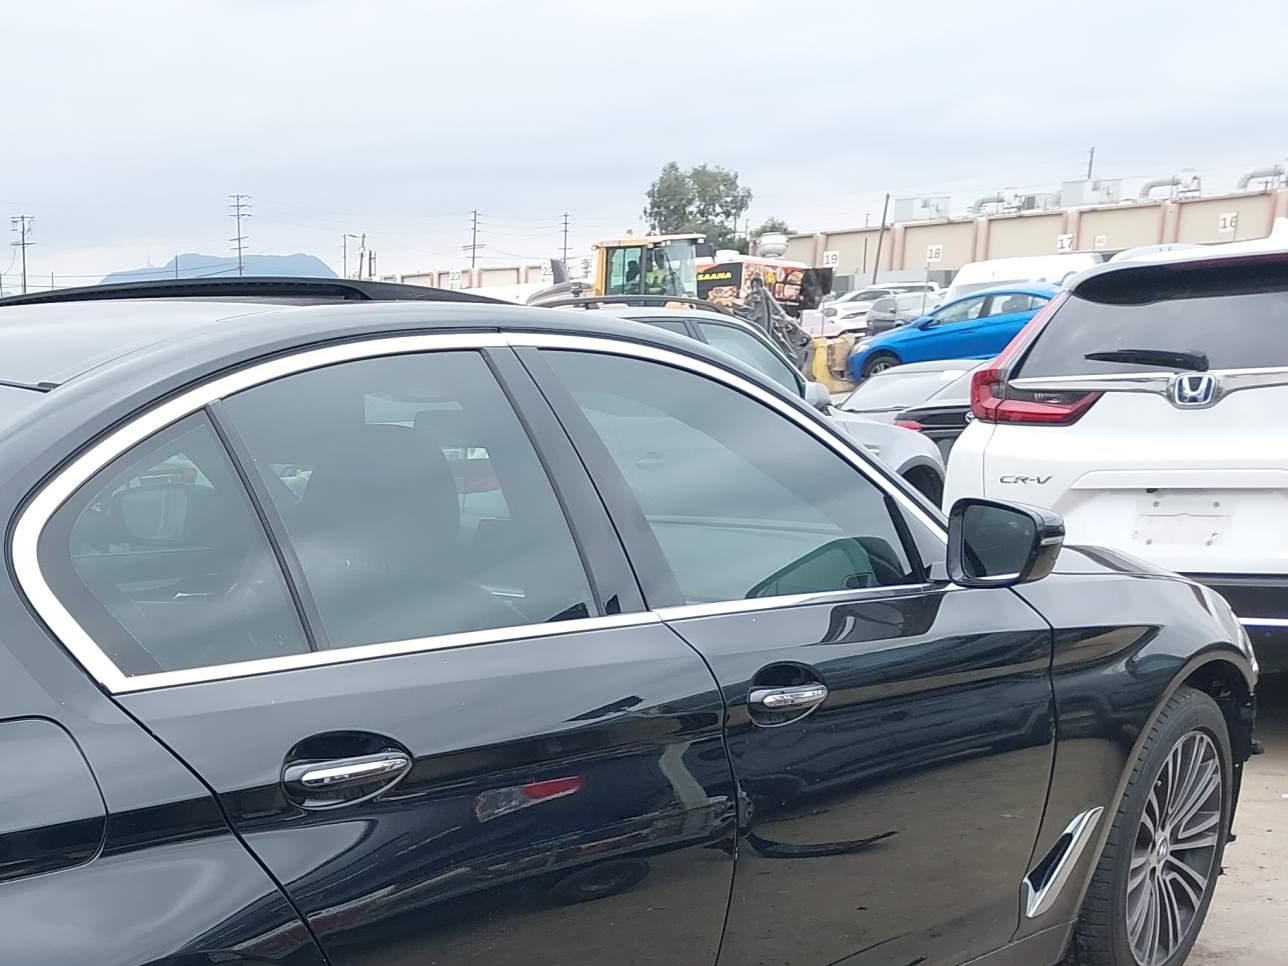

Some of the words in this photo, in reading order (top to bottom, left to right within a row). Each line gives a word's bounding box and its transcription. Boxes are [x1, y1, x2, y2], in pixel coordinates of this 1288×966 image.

[1057, 236, 1073, 249] 17
[927, 248, 940, 259] 18
[825, 254, 838, 265] 19
[999, 475, 1053, 485] CR-V
